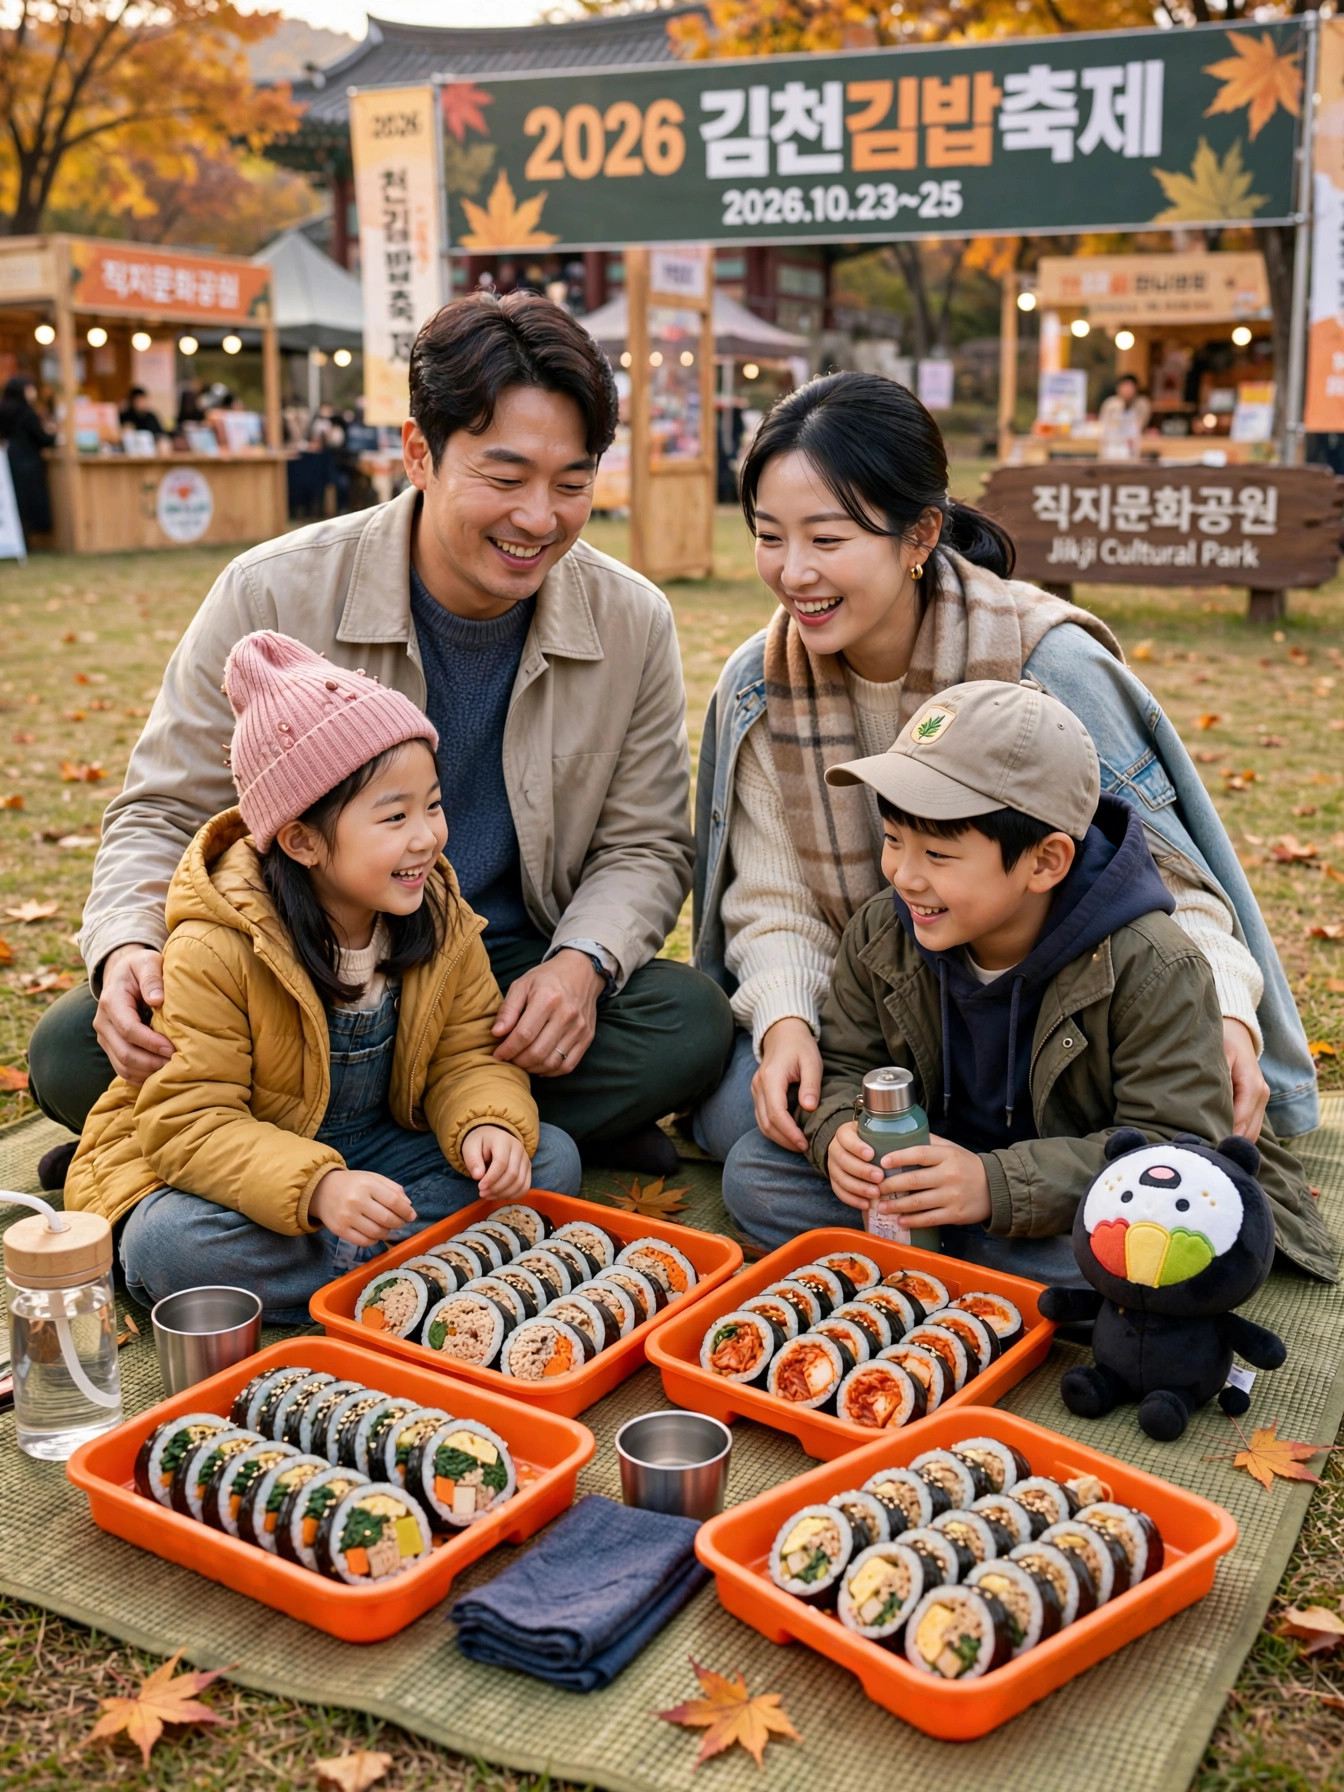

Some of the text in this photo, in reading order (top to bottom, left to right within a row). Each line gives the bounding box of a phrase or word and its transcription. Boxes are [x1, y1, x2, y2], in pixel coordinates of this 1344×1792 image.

[523, 59, 1165, 181] 2026 김천김밥축제
[721, 180, 963, 226] 2026.10.23~25
[1032, 484, 1278, 535] 직지문화공원
[1100, 537, 1197, 567] Cultural
[1201, 538, 1260, 569] Park
